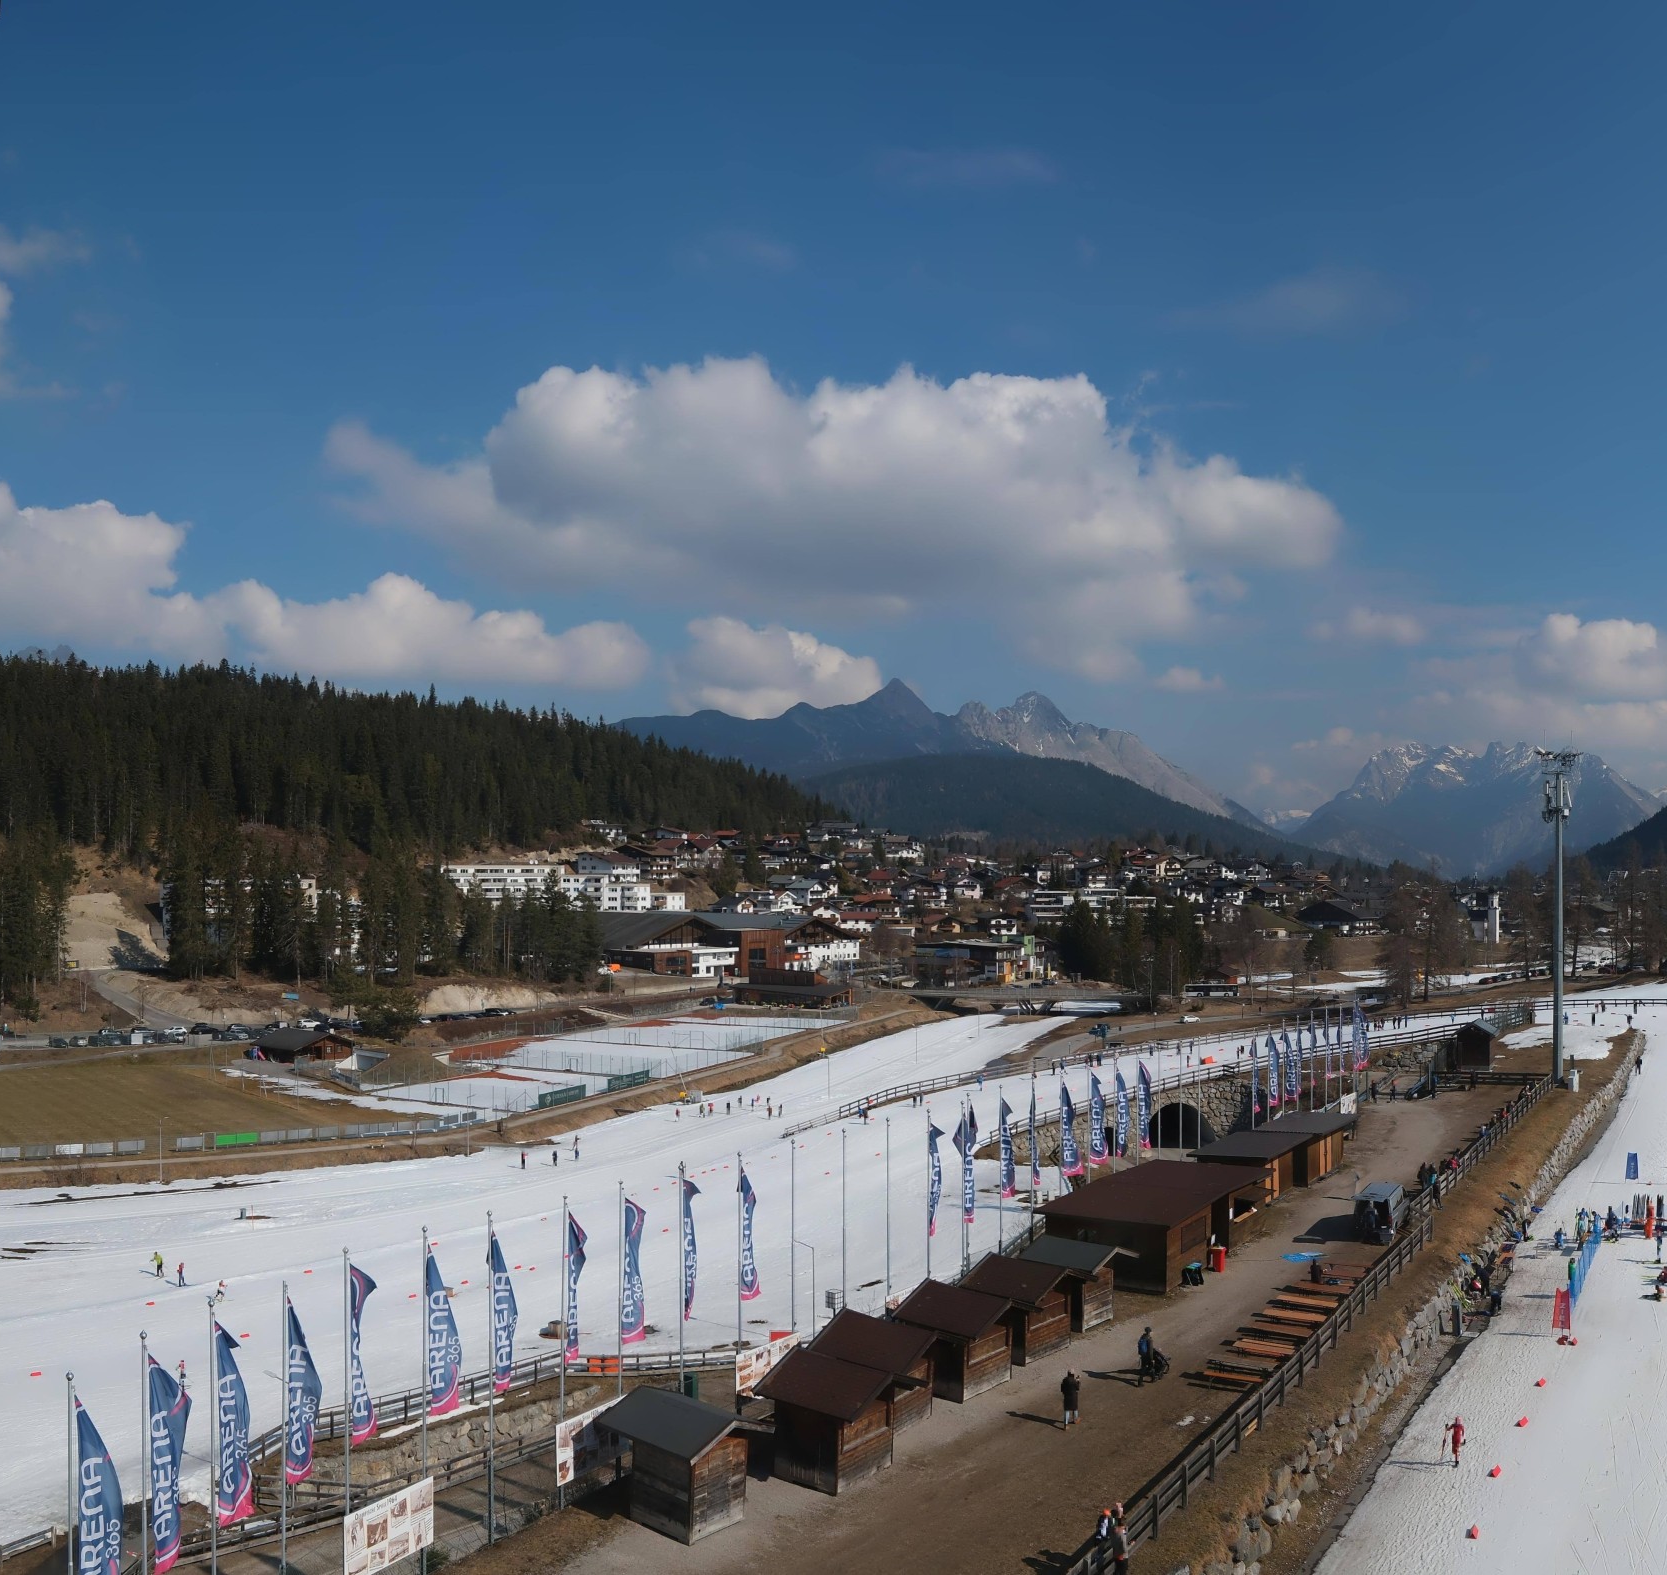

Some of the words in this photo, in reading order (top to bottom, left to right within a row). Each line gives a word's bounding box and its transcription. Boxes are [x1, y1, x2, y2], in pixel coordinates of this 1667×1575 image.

[493, 1272, 512, 1367] ARENA
[633, 1275, 644, 1301] 365
[428, 1290, 449, 1389] ARENA
[446, 1336, 461, 1364] 365
[217, 1373, 238, 1494] ARENA
[301, 1396, 317, 1425] 365
[150, 1410, 173, 1541] ARENA
[235, 1428, 248, 1462] 365
[80, 1457, 105, 1575] RENA
[105, 1519, 121, 1560] 365
